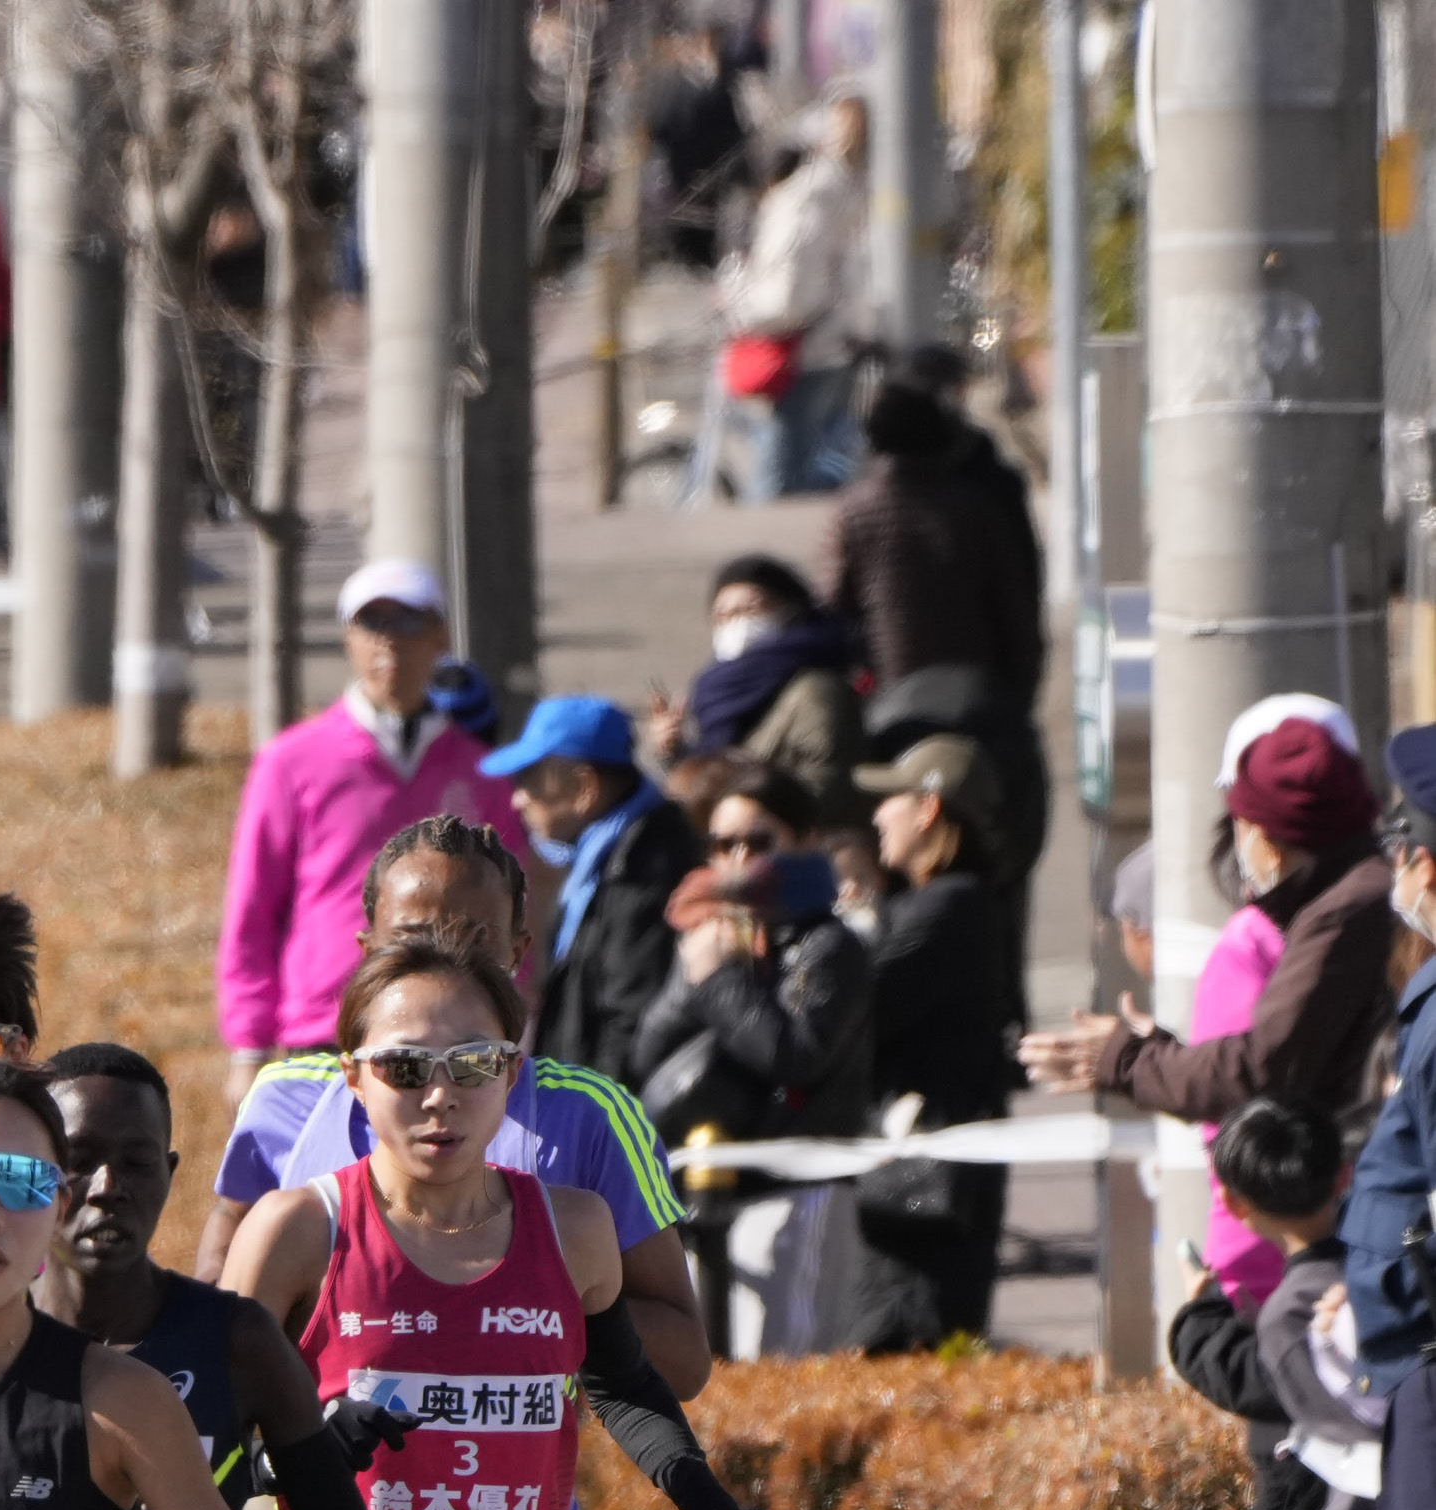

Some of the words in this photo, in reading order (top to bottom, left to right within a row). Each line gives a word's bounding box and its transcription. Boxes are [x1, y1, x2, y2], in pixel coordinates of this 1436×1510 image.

[338, 1311, 438, 1337] 第一生命
[481, 1307, 564, 1339] HOKA
[418, 1381, 557, 1426] 奥村組
[453, 1440, 479, 1476] 3
